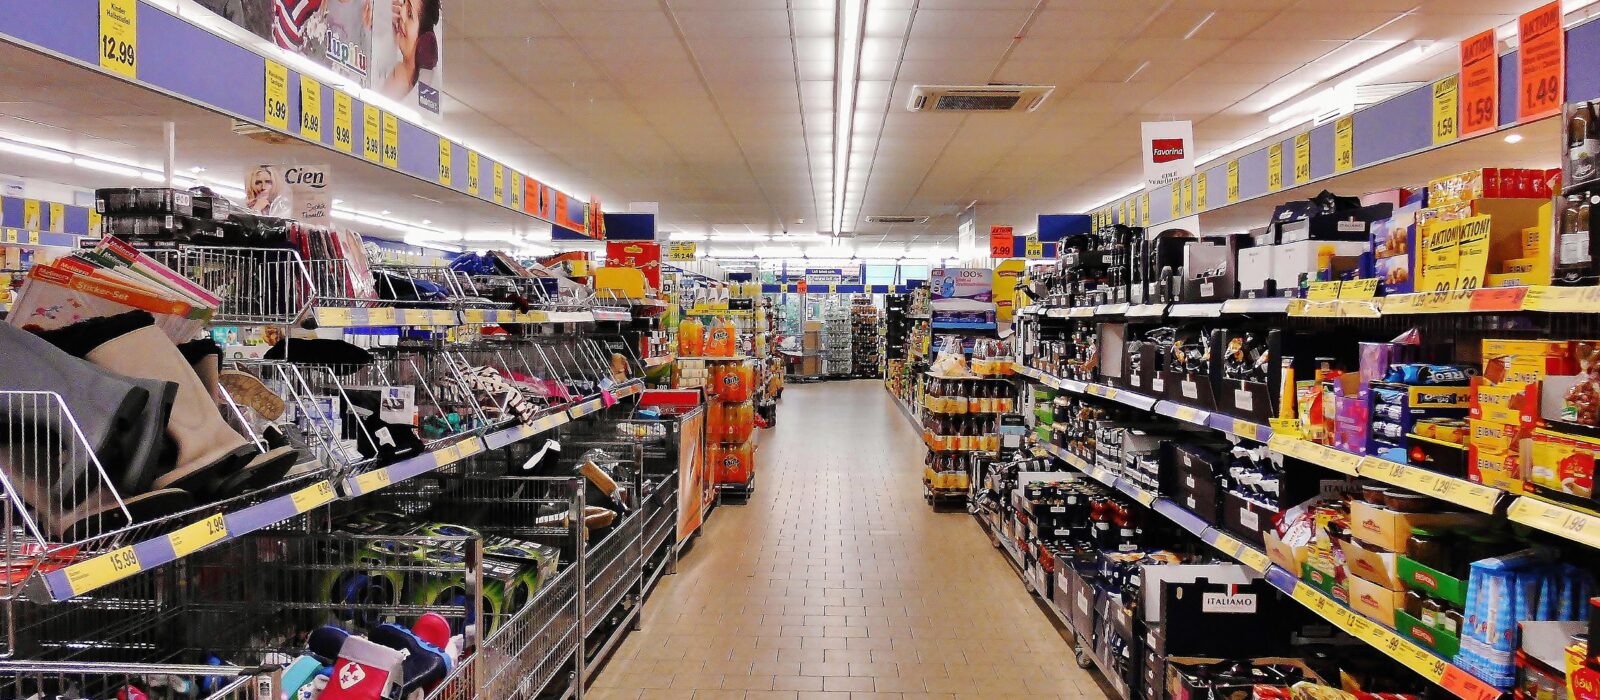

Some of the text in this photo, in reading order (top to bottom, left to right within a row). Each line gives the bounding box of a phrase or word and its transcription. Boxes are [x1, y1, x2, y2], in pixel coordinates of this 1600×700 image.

[103, 34, 134, 66] 12.99
[1527, 76, 1558, 109] 1.49
[268, 98, 286, 120] 5.99
[1467, 97, 1493, 126] 1.59
[304, 112, 319, 132] 6.99
[1437, 117, 1453, 138] 1.59
[336, 126, 350, 144] 9.99
[1153, 148, 1183, 156] Favorina
[284, 168, 324, 187] Cien
[993, 246, 1010, 255] 2.99
[60, 262, 90, 277] Melinera
[77, 281, 129, 300] Sticker-Set
[1452, 276, 1477, 300] 1.39
[713, 332, 728, 340] Fanta
[723, 376, 739, 384] Fanta
[723, 459, 740, 467] Fanta
[207, 516, 225, 536] 2.99
[1562, 513, 1587, 532] 1.99
[110, 549, 137, 572] 15.99
[1207, 597, 1253, 606] ITALIAMO
